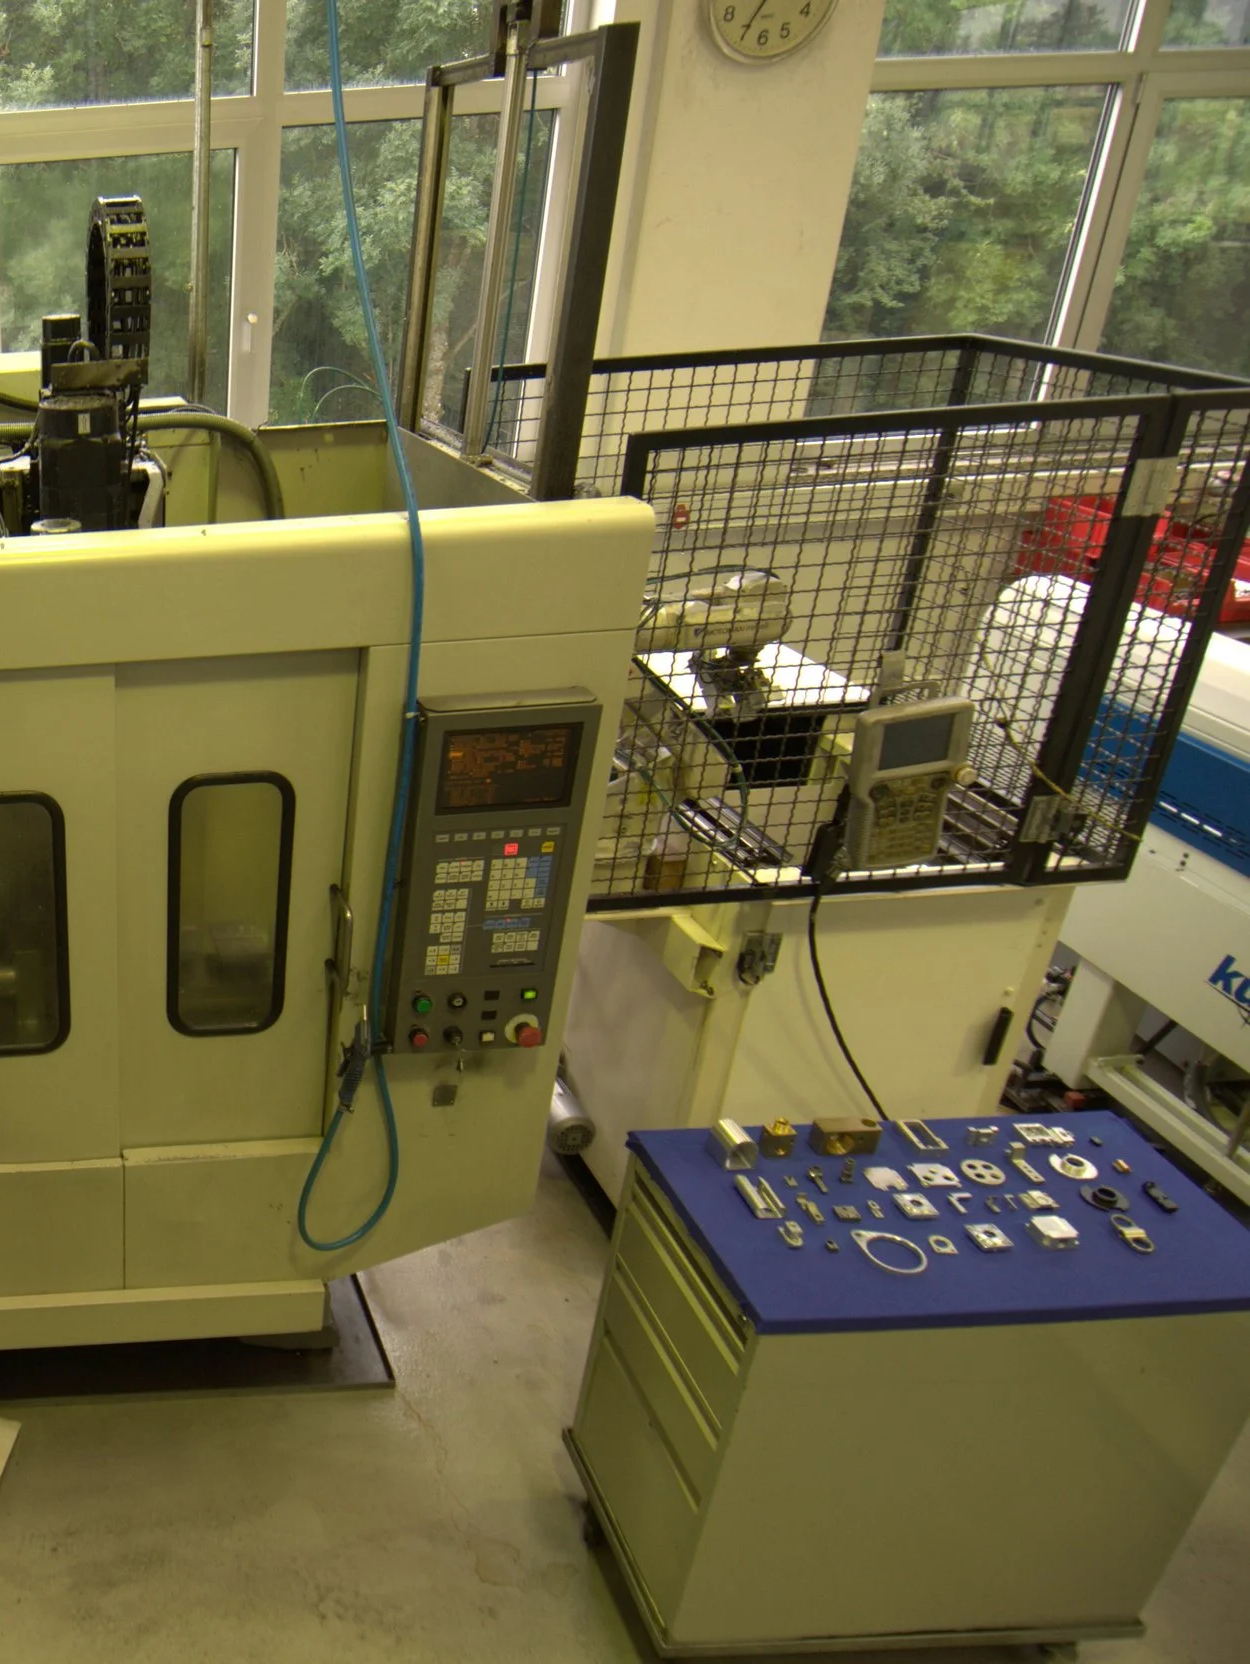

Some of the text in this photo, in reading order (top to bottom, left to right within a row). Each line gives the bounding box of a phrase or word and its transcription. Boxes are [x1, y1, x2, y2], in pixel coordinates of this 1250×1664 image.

[723, 5, 736, 22] 8
[798, 1, 811, 18] 4
[741, 23, 751, 41] 7
[757, 29, 769, 46] 6
[780, 22, 791, 39] 5
